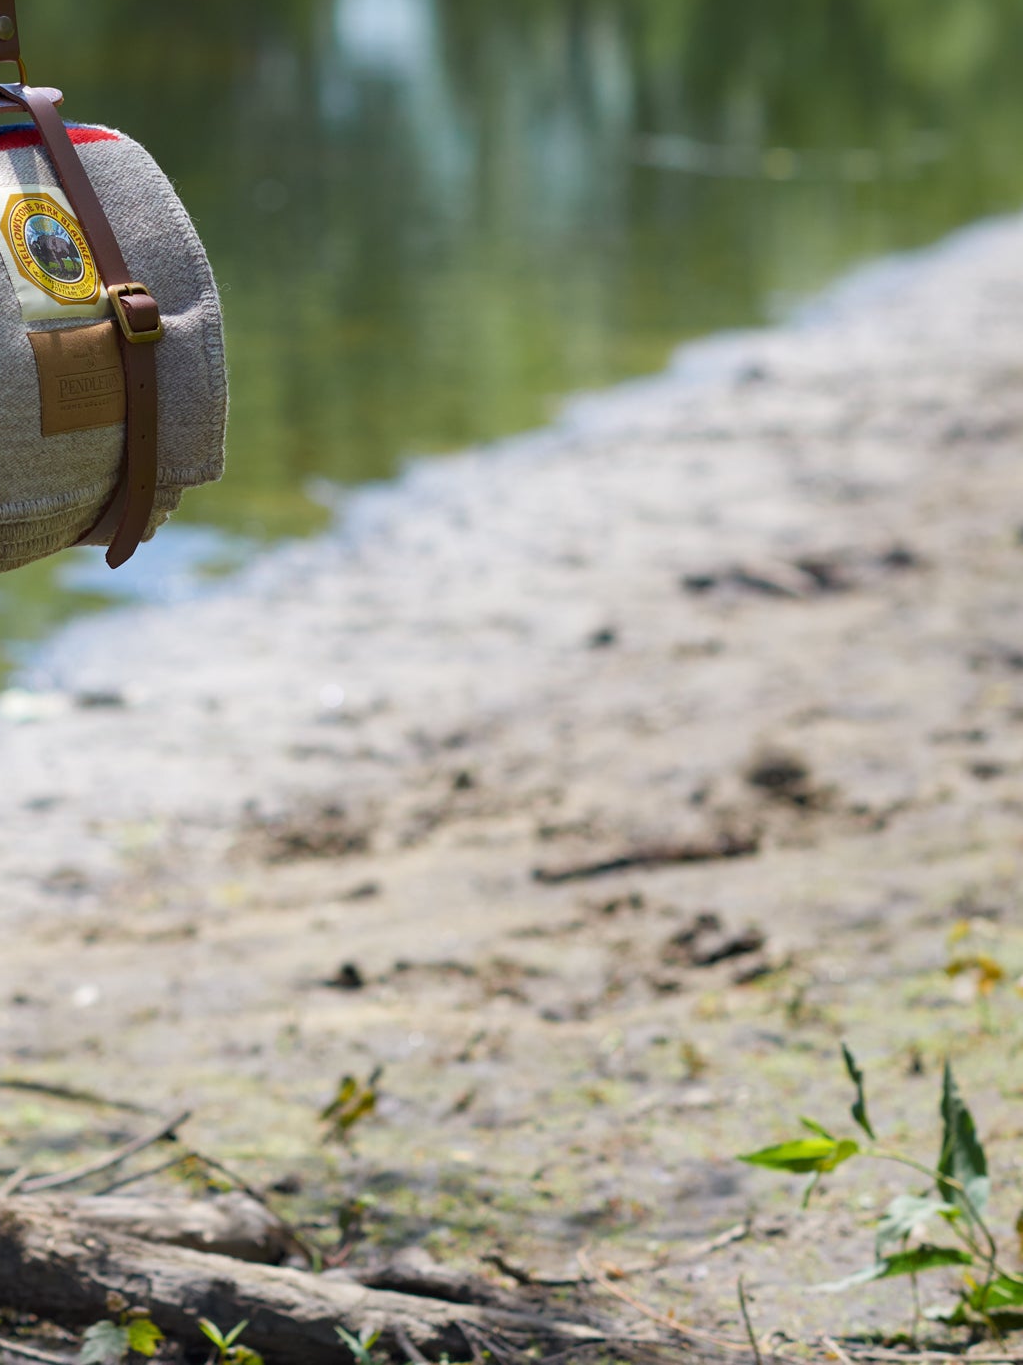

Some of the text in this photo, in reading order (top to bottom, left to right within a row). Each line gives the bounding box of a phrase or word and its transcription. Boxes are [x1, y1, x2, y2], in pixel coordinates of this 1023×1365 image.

[11, 202, 93, 269] YELLOWSTONE PARK BLANKET
[59, 372, 120, 399] PENDLETON
